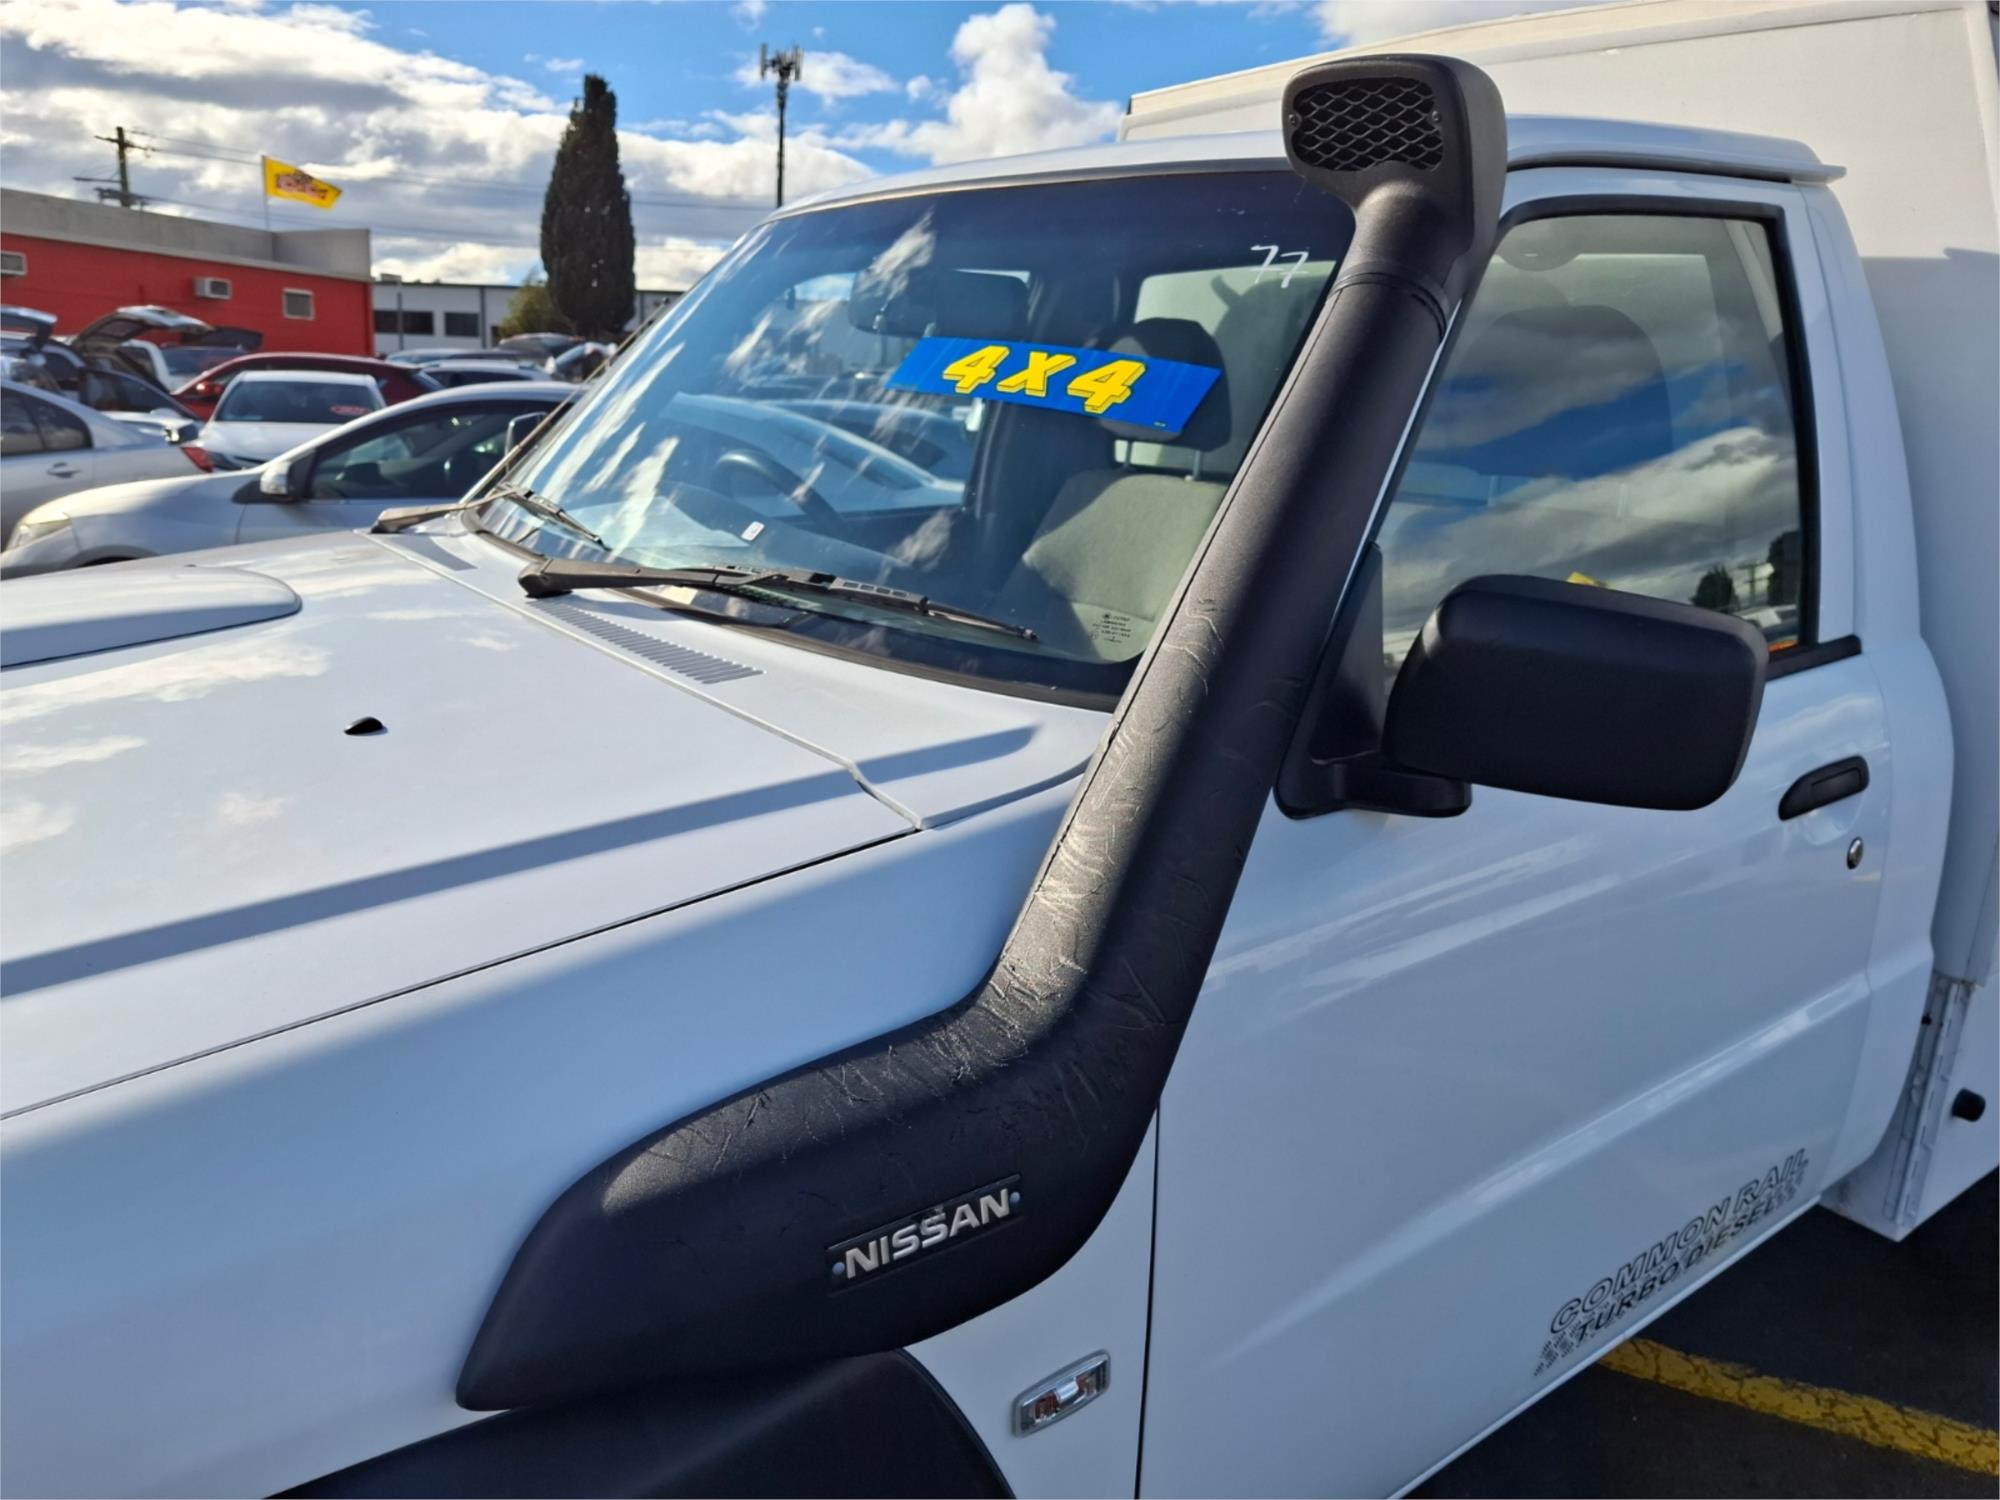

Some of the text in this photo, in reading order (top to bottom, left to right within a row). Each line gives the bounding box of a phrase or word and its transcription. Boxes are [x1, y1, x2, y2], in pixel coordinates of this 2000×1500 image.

[1250, 244, 1309, 289] 77
[941, 344, 1147, 415] 4X4
[845, 1187, 1010, 1280] NISSAN
[1550, 1147, 1809, 1334] COMMON RAIL
[1576, 1196, 1775, 1345] TURBO DIESEL
